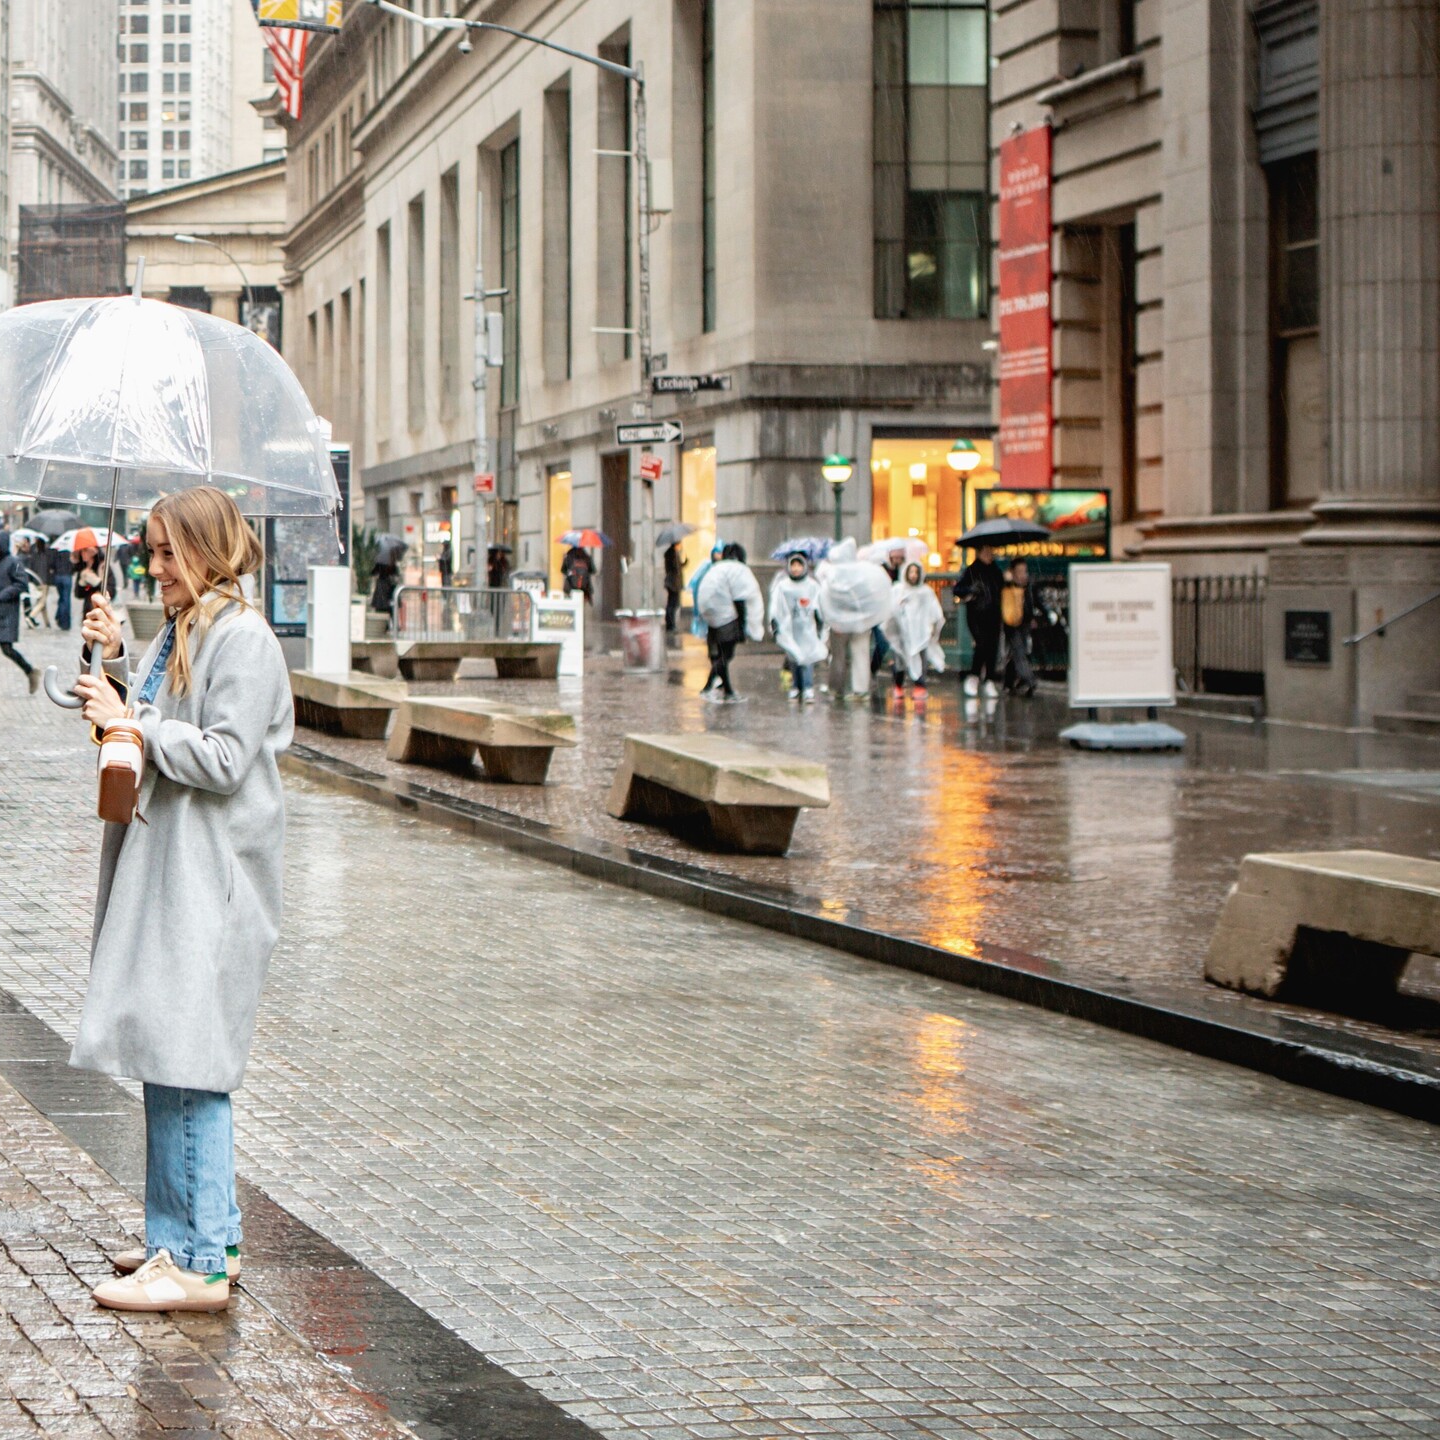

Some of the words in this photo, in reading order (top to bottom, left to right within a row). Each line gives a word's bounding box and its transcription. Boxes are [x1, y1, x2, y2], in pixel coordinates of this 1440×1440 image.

[657, 378, 699, 391] Exchange
[622, 430, 639, 439] ONE
[652, 428, 673, 437] WAY
